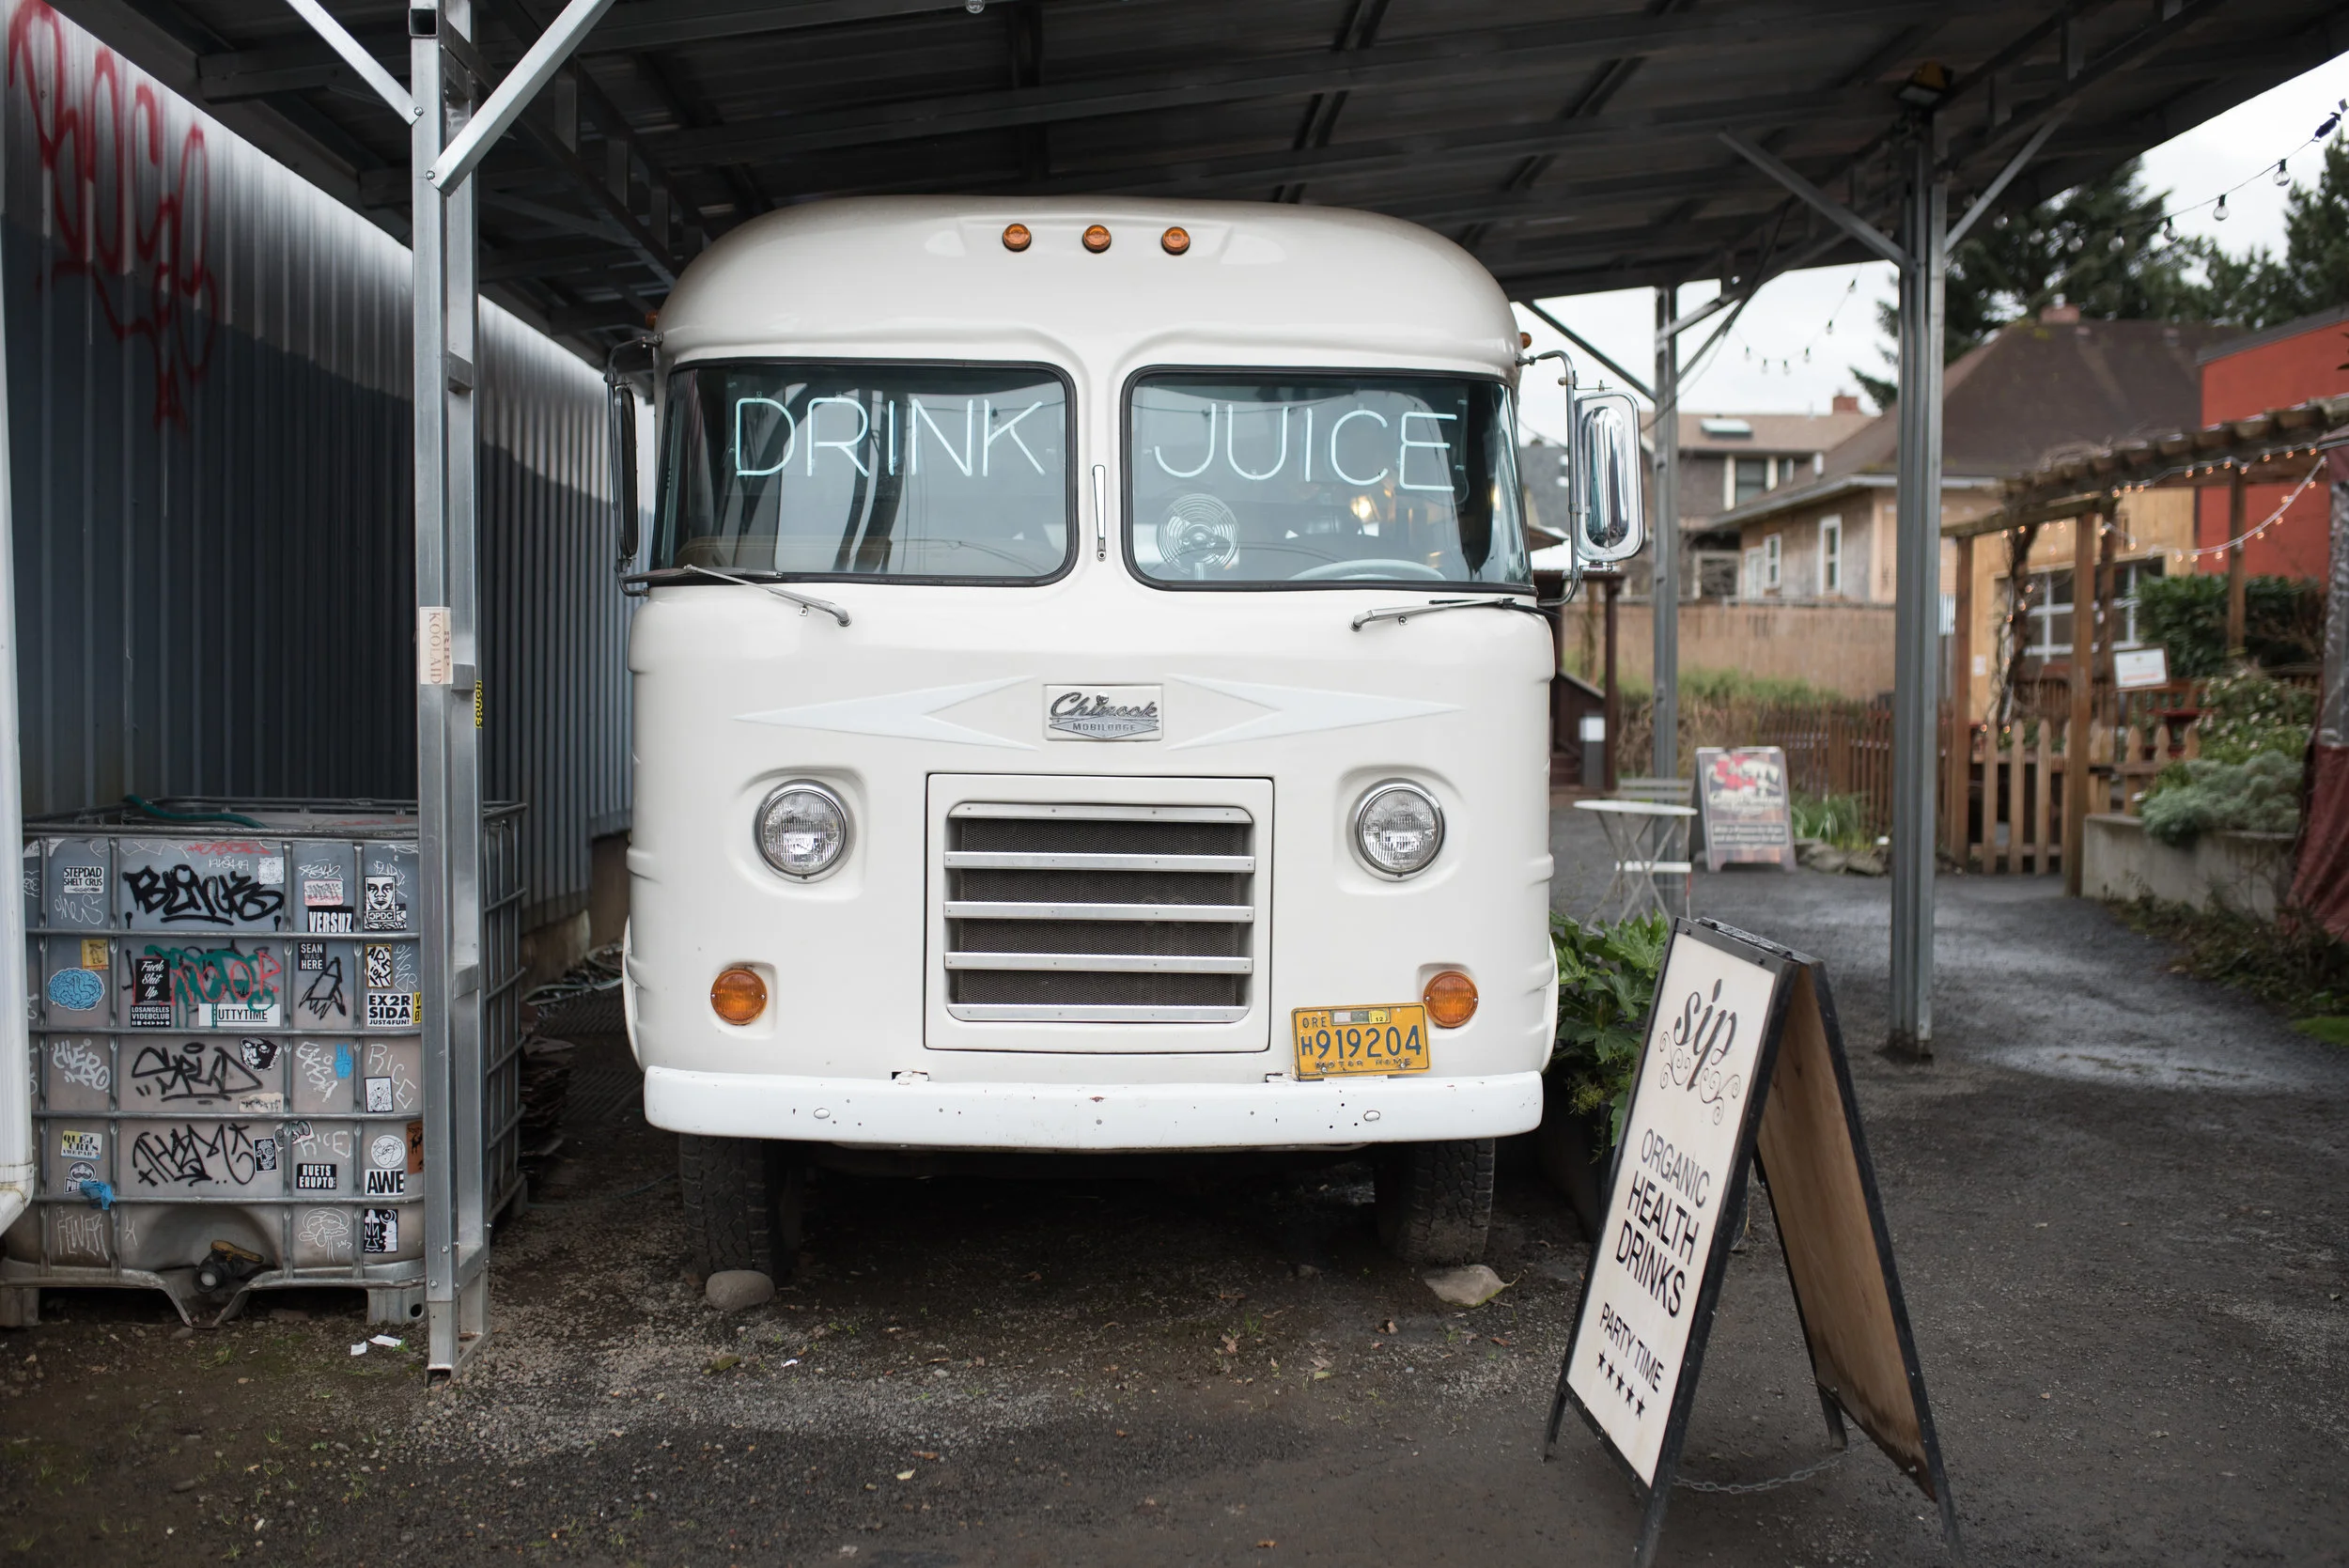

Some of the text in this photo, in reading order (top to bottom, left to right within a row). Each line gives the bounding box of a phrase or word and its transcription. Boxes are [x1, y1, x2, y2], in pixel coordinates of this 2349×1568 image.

[735, 396, 1458, 491] DRINK JUICE
[428, 613, 443, 685] KOOLAID
[1050, 691, 1158, 718] Chinook
[64, 867, 102, 877] STEPDAD
[63, 877, 83, 887] SHELT
[309, 911, 352, 932] VERSUZ
[301, 943, 323, 954] SEAN
[141, 960, 164, 972] Fuck
[301, 960, 323, 970] HERE
[141, 972, 163, 985] Shit
[145, 986, 159, 999] Up
[368, 995, 411, 1006] EX2R
[368, 1006, 411, 1018] SIDA
[1302, 1016, 1327, 1029] ORE
[1673, 978, 1737, 1092] sip
[1301, 1025, 1422, 1059] H919204
[1315, 1059, 1363, 1068] MOTOR
[1641, 1127, 1710, 1209] ORGANIC
[1626, 1171, 1700, 1266] HEALTH
[1615, 1219, 1686, 1318] DRINKS
[1599, 1301, 1665, 1394] PARTY TIME
